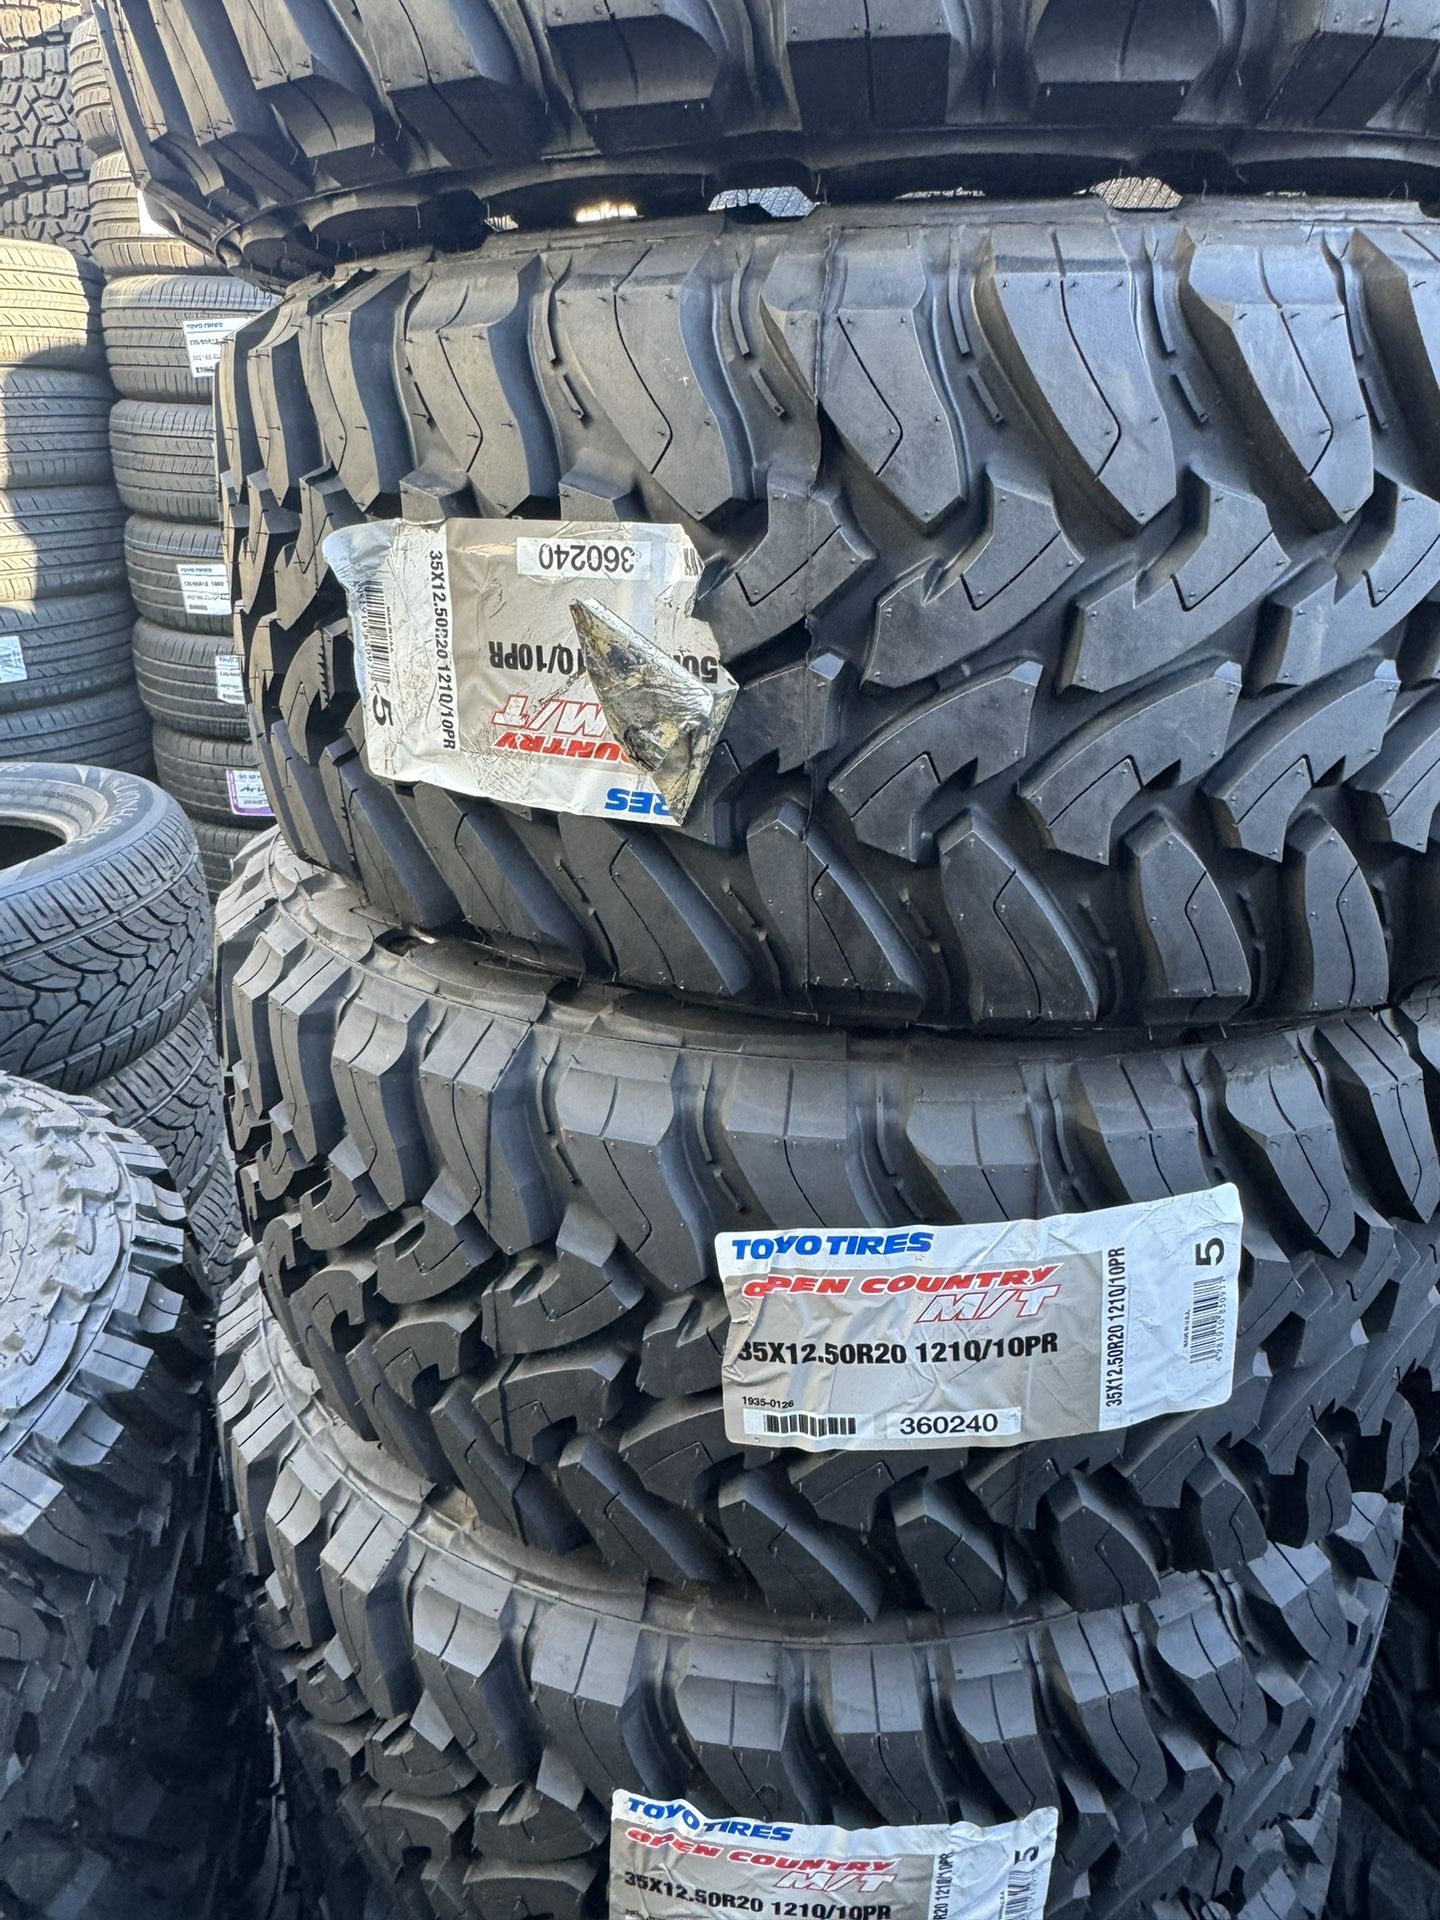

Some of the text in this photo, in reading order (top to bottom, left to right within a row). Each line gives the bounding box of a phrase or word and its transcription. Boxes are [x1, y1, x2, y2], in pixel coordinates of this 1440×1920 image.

[538, 543, 635, 574] 360240
[372, 692, 394, 727] 5
[491, 694, 608, 739] M/T
[732, 1231, 934, 1260] TOYO TIRES
[1195, 1237, 1225, 1267] 5
[743, 1264, 1063, 1298] OPEN COUNTRY
[914, 1284, 1060, 1324] M/T
[1105, 1246, 1126, 1408] 35X12.50R20 121Q/10PR
[738, 1332, 1059, 1366] 35X12.50R20 121Q/10PR
[742, 1395, 794, 1409] 1935-0126
[899, 1413, 999, 1436] 360240
[628, 1797, 793, 1842] TOYO TIRES
[626, 1829, 901, 1873] OPEN COUNTRY
[1013, 1845, 1040, 1866] 5
[624, 1870, 892, 1920] 35X12.50R20 121Q/10PR
[772, 1870, 897, 1894] M/T
